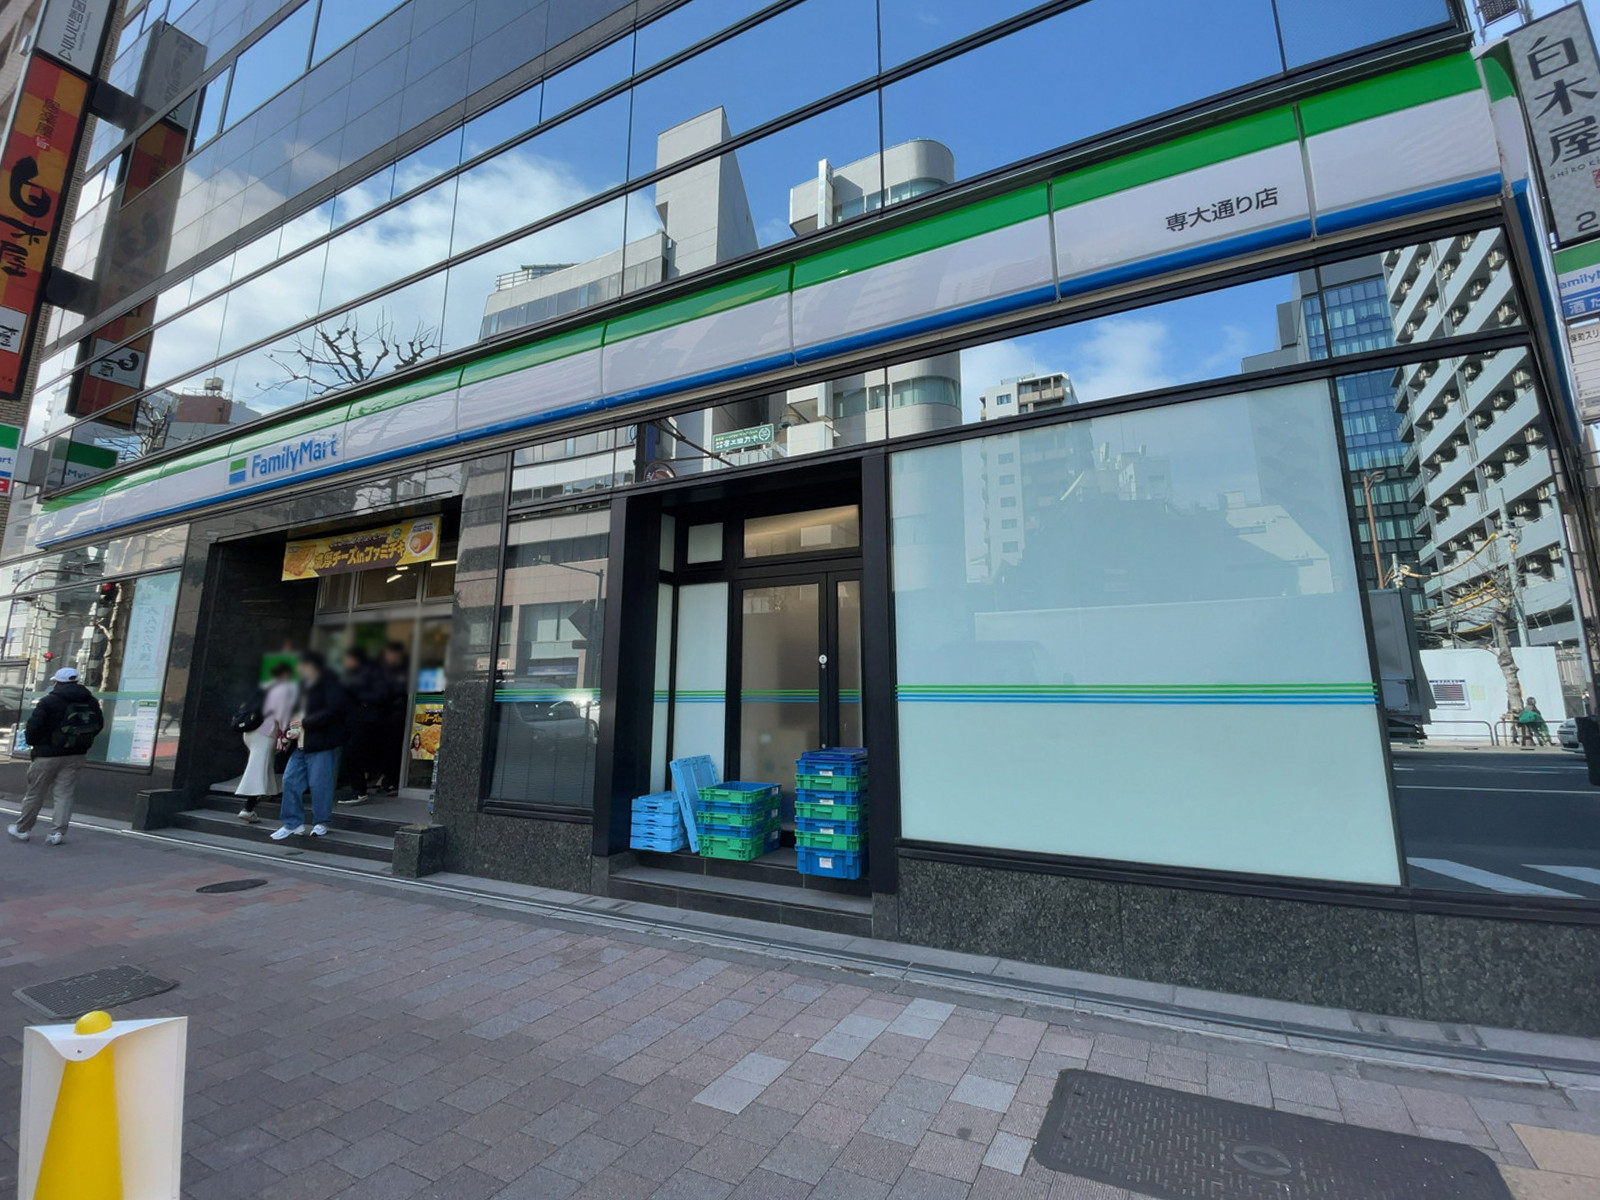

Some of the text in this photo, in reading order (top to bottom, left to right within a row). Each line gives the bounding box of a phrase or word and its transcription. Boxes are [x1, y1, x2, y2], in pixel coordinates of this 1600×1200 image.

[1527, 35, 1600, 167] 白木屋
[1165, 186, 1279, 232] 専大通り店
[251, 433, 339, 478] FamilyMart
